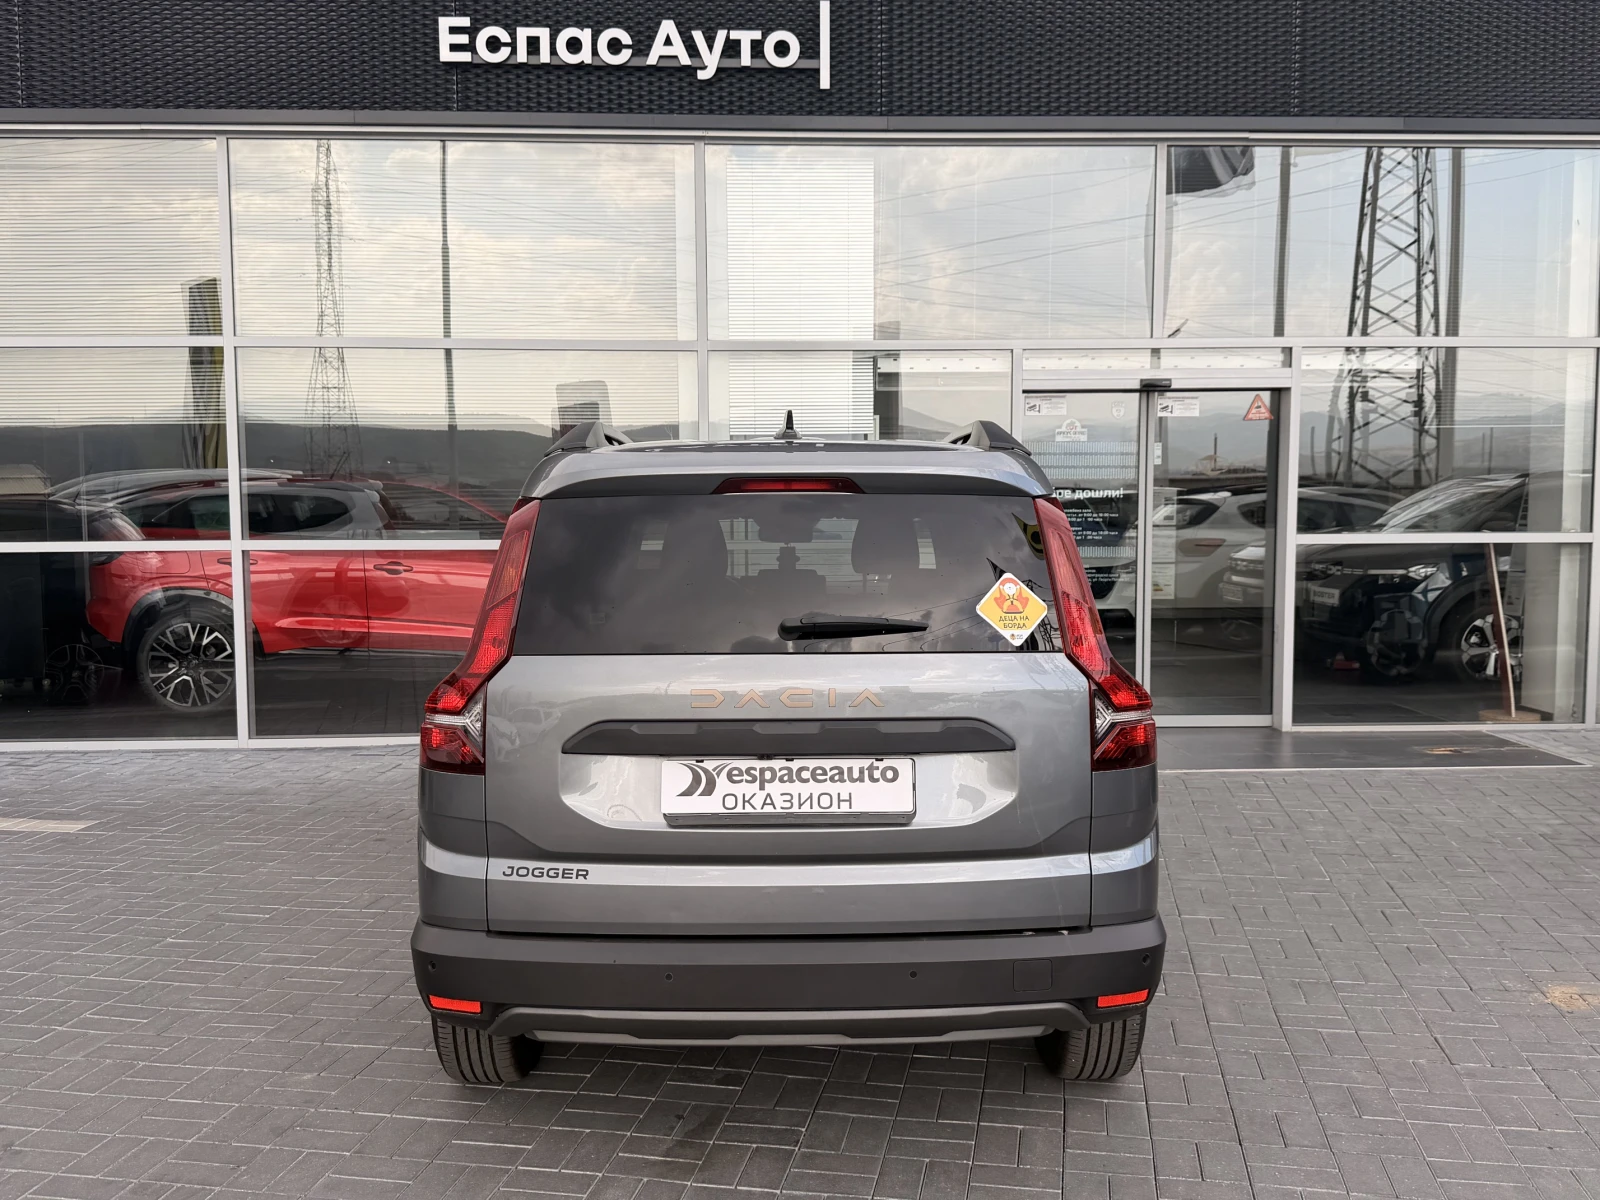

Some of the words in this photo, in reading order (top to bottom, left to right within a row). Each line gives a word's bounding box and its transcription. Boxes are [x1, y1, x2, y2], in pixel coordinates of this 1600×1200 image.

[437, 16, 633, 66] Еспас
[645, 19, 801, 80] Ауто
[1074, 487, 1124, 500] дошли!
[690, 687, 886, 709] DACIA
[725, 761, 901, 791] espaceauto
[721, 792, 853, 811] ОКАЗИОН
[502, 865, 590, 880] JOGGER
